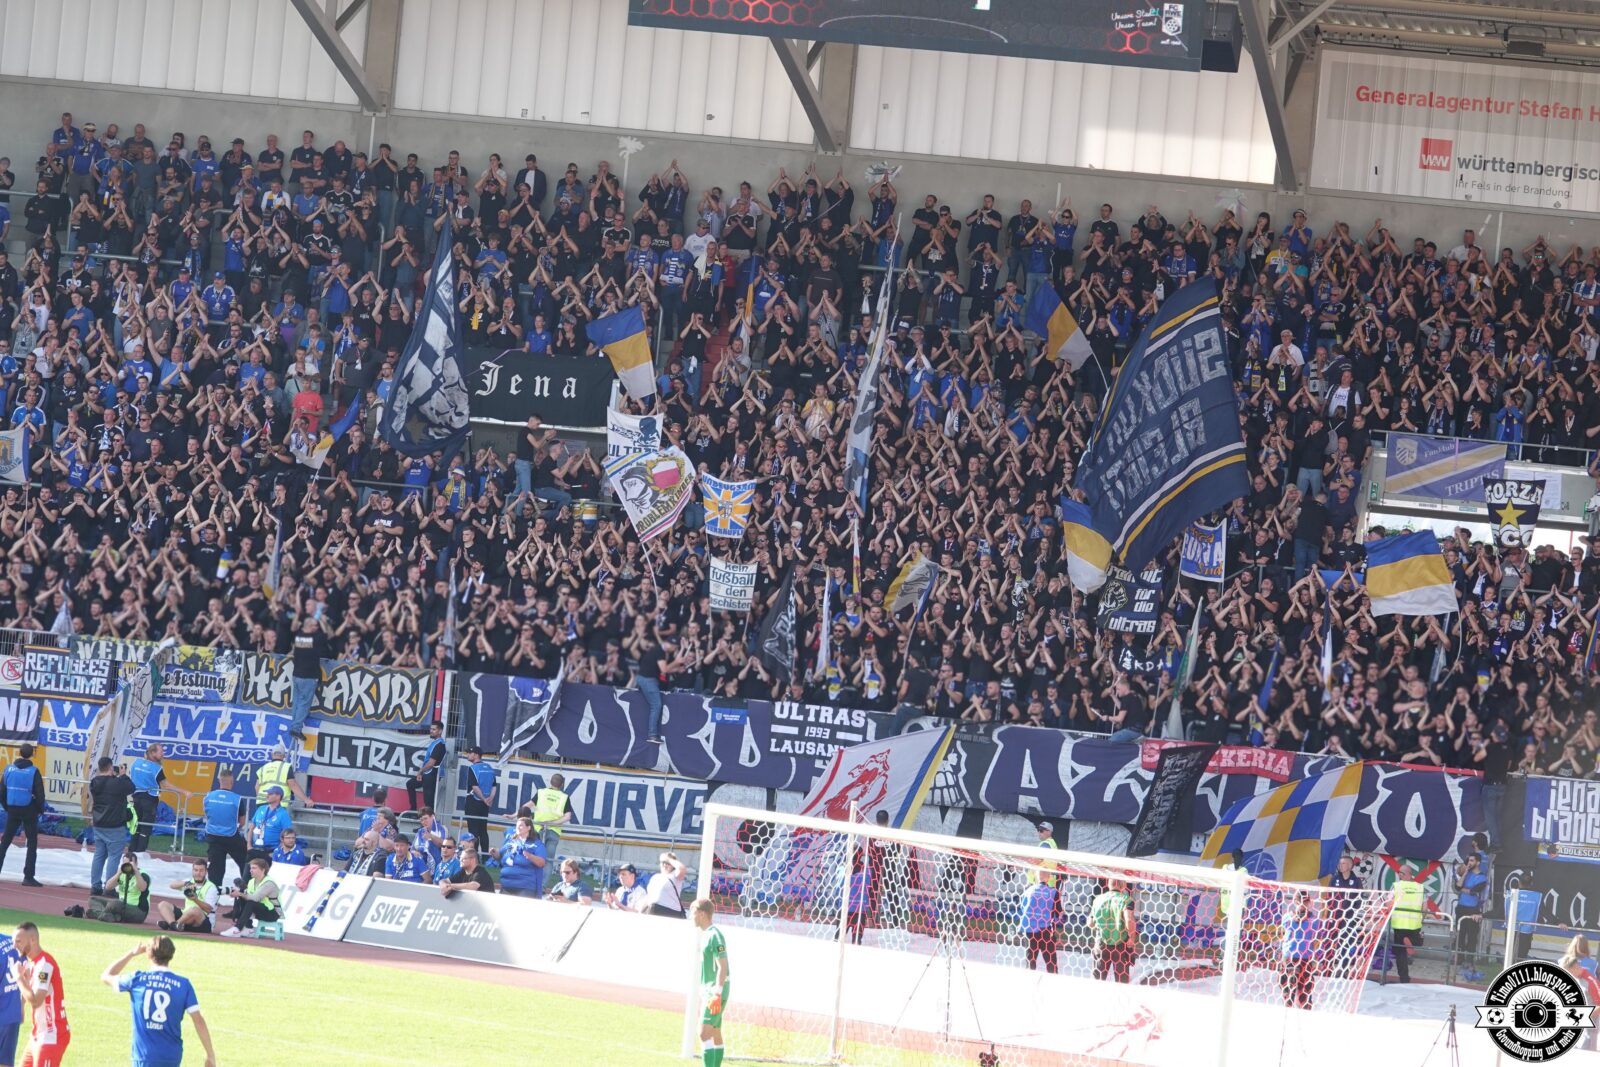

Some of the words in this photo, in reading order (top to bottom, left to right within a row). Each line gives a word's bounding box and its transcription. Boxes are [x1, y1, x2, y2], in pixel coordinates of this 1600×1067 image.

[1356, 85, 1515, 115] Generalagentur
[1519, 100, 1583, 121] Stefan
[1455, 179, 1469, 189] Ihr
[1471, 180, 1491, 191] Fels
[1493, 182, 1502, 191] in
[1504, 183, 1520, 193] der
[1523, 185, 1573, 199] Brandung.
[475, 360, 578, 399] Jena
[1444, 468, 1500, 497] TRIPTS
[725, 586, 747, 598] den
[1135, 588, 1156, 600] für
[1133, 601, 1154, 613] die
[1108, 616, 1157, 633] ultras
[25, 652, 110, 677] REFUGEES
[24, 671, 107, 696] WELCOME
[173, 669, 226, 694] Festung
[247, 655, 431, 719] HAAKIRI
[49, 699, 293, 748] WIMAR
[774, 701, 866, 727] ULTRAS
[805, 726, 830, 739] 1993
[313, 732, 427, 776] ULTRAS
[770, 738, 847, 758] LAUSAN
[370, 902, 411, 926] SWE
[417, 908, 449, 932] Für
[448, 912, 499, 940] Erfurt.
[146, 981, 172, 991] JENA
[143, 989, 171, 1023] 18
